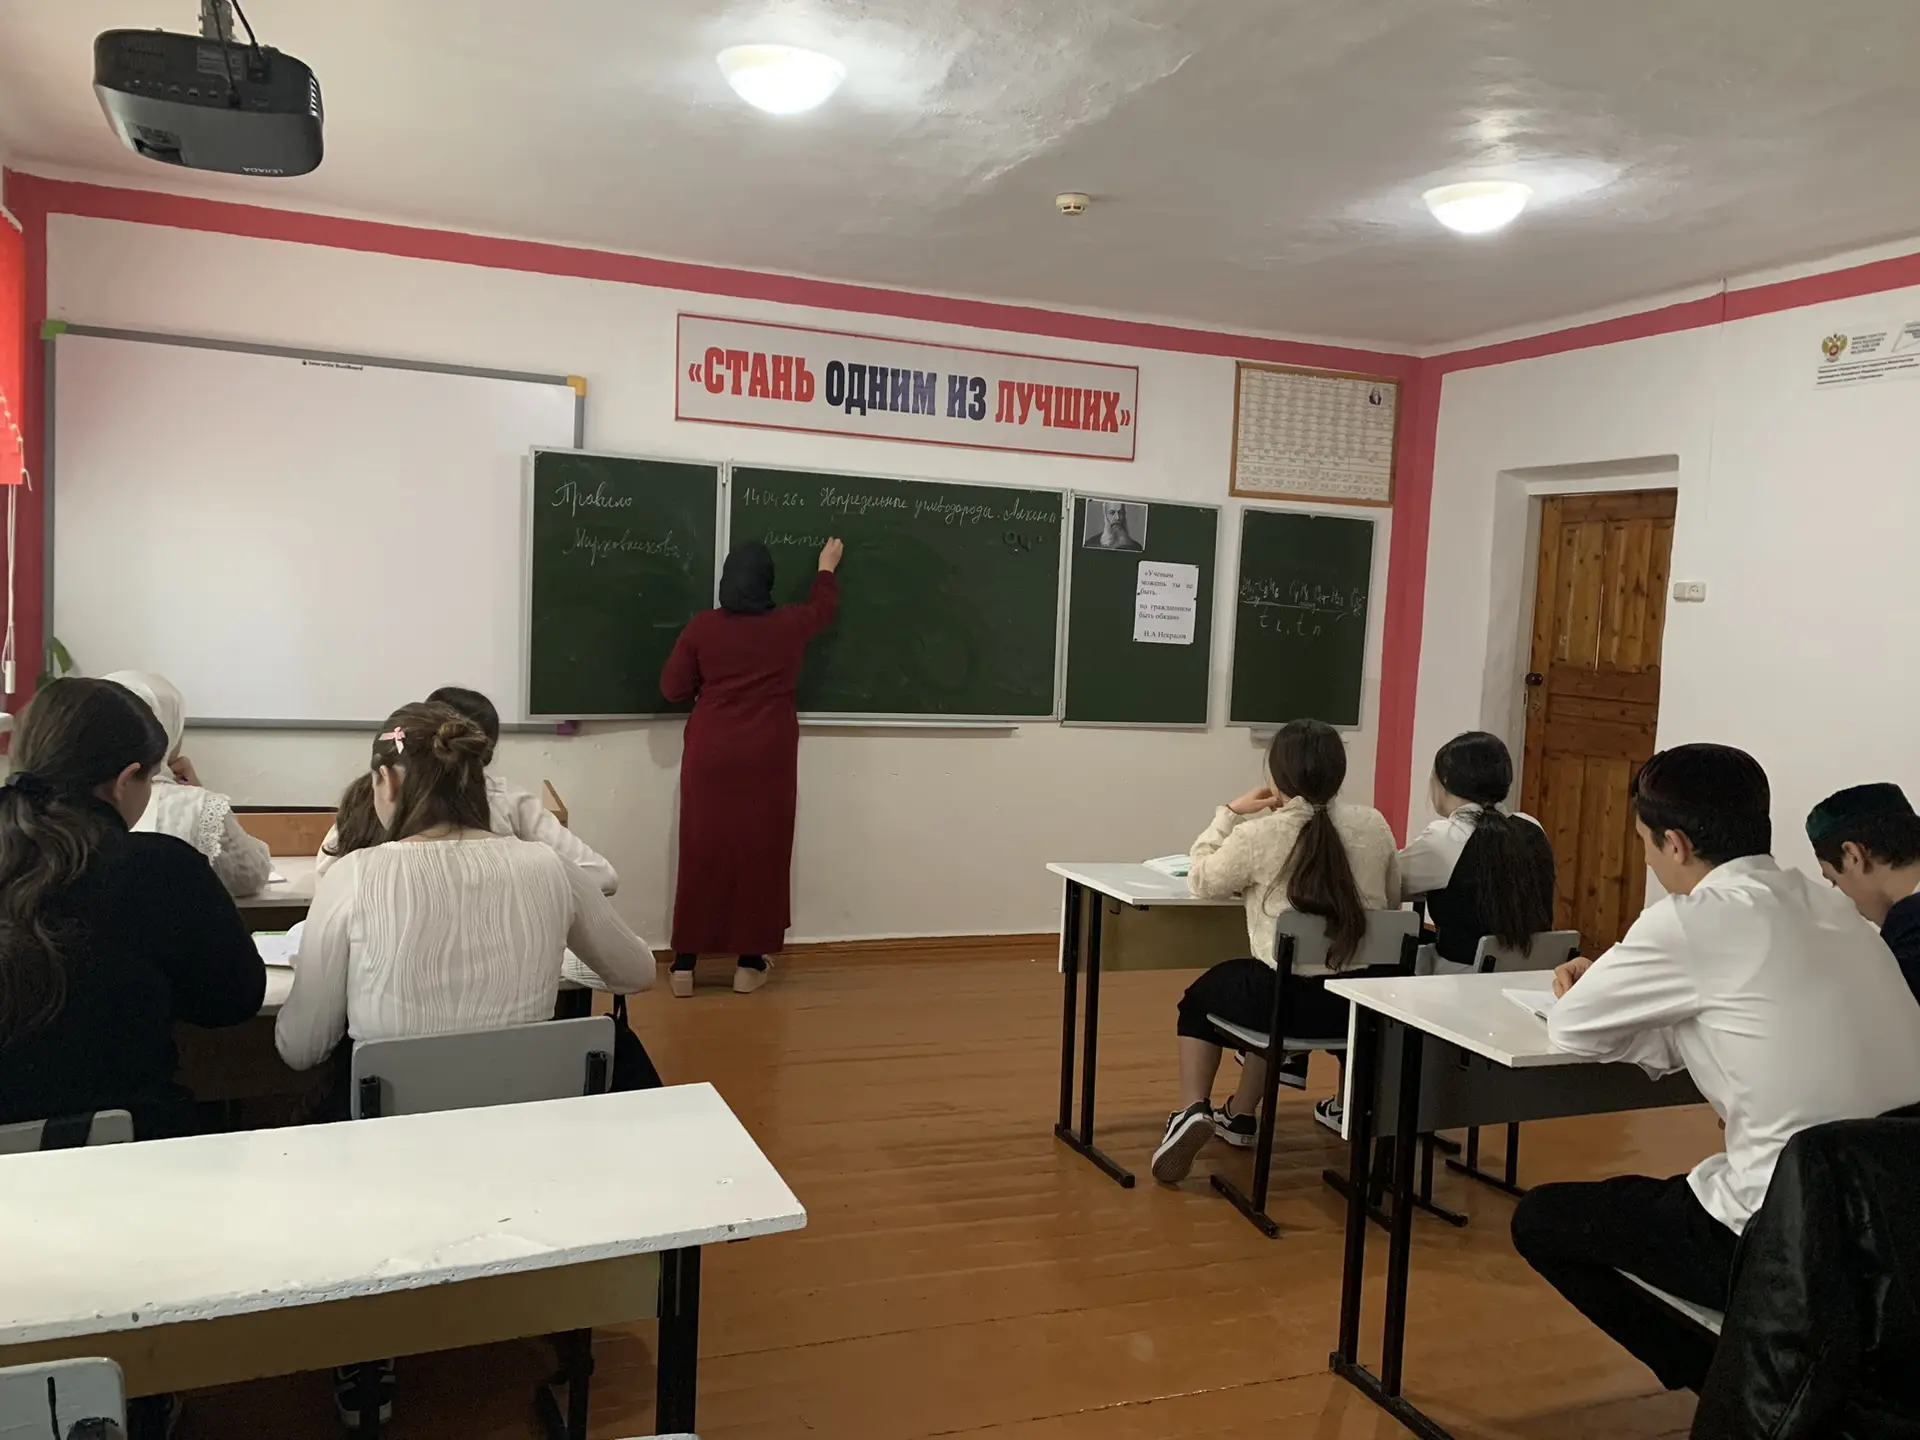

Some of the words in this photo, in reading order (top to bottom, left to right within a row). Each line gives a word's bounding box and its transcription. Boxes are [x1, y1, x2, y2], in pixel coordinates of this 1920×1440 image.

[688, 346, 815, 403] «СТАНЬ
[825, 359, 937, 416] ОДНИМ
[946, 374, 987, 421] ИЗ
[994, 380, 1132, 433] ЛУЧШИХ»
[551, 480, 634, 517] Правило
[1158, 631, 1187, 640] Некрасов
